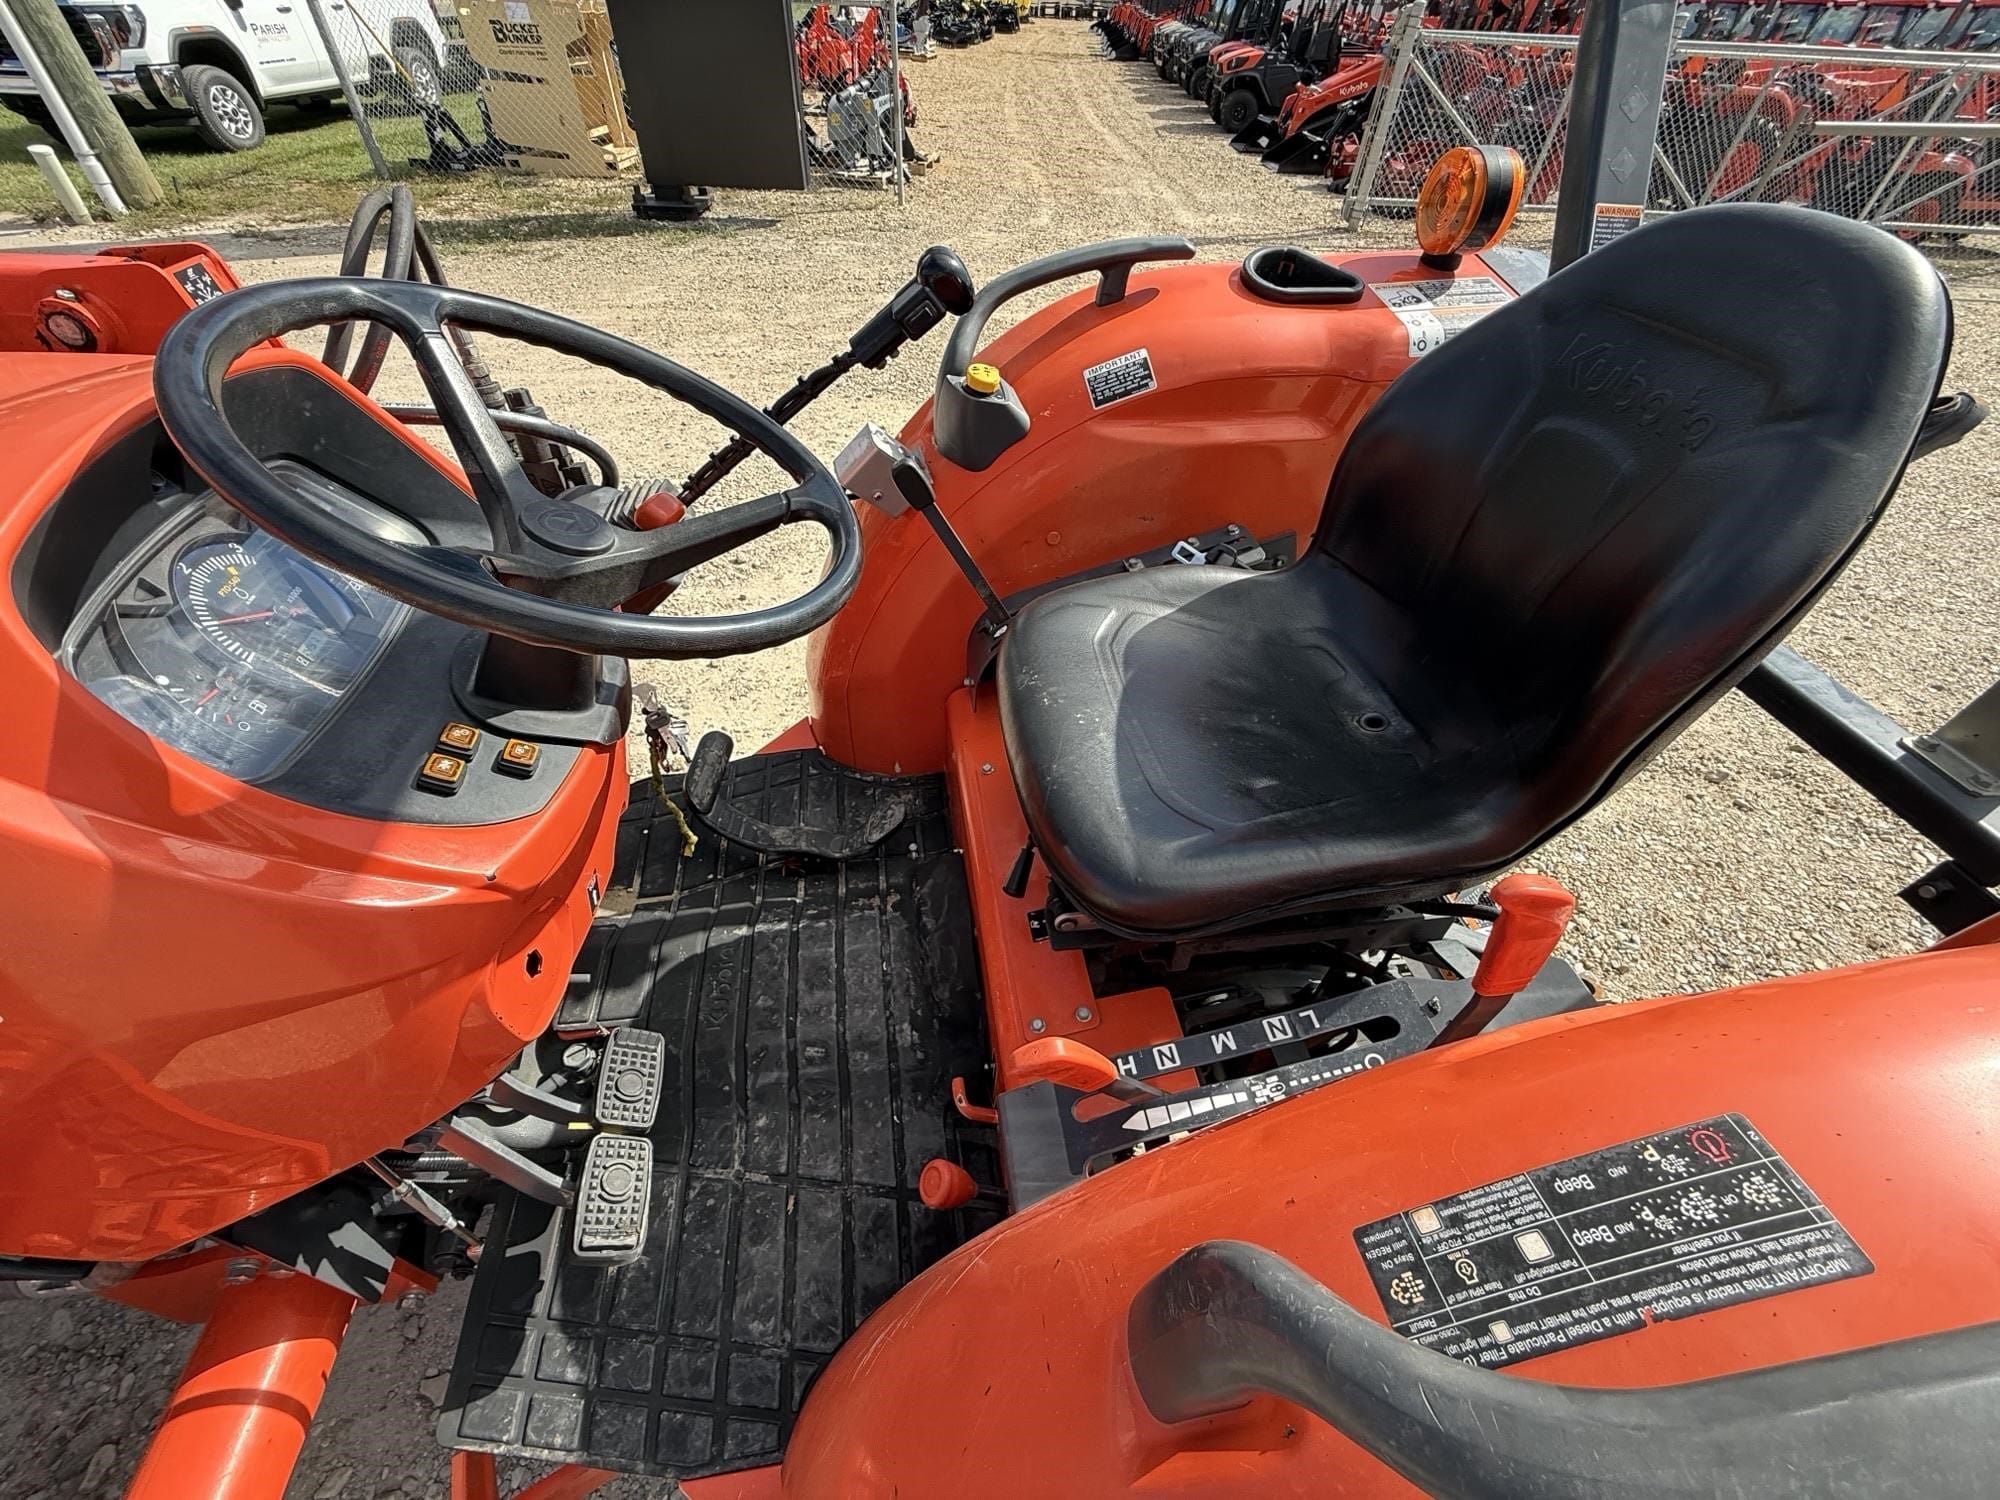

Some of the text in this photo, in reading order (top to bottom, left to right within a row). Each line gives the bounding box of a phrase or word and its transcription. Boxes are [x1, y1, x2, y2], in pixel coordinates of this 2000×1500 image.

[250, 23, 288, 36] PARISH
[1340, 81, 1368, 96] Kubota
[1604, 206, 1640, 216] WARNING
[1087, 351, 1141, 375] IMPORTANT
[229, 543, 243, 553] 3
[177, 563, 192, 575] 2
[1117, 1010, 1320, 1075] L N M N H
[1745, 1130, 1760, 1141] 2
[1489, 1178, 1513, 1190] REGEN
[1550, 1164, 1629, 1198] AND Beep
[1439, 1183, 1531, 1217] then RPM automatically increases
[1506, 1197, 1521, 1206] OFF
[1519, 1191, 1537, 1202] Inhibit
[1719, 1193, 1739, 1205] OR
[1483, 1203, 1500, 1214] Push
[1503, 1206, 1525, 1218] Control
[1523, 1199, 1543, 1211] Speed
[1463, 1219, 1484, 1230] neutral
[1488, 1212, 1506, 1223] Pedal
[1360, 1227, 1394, 1244] complete.
[1435, 1209, 1549, 1251] Park outside Parking brake ON PTO OFF
[1438, 1226, 1461, 1239] Throttle
[1568, 1220, 1635, 1250] AND Beep
[1421, 1236, 1433, 1245] idle
[1669, 1230, 1742, 1256] If you see/hear
[1752, 1238, 1781, 1254] flash,
[1778, 1229, 1824, 1249] indicators
[1831, 1242, 1843, 1251] If
[1365, 1238, 1408, 1259] until REGEN
[1727, 1245, 1757, 1260] follow
[1794, 1251, 1807, 1260] is
[1803, 1243, 1835, 1258] tractor
[1380, 1251, 1414, 1269] Stays ON
[1558, 1258, 1578, 1270] Push
[1675, 1258, 1707, 1273] below.
[1703, 1252, 1731, 1266] chart
[1745, 1258, 1771, 1272] used
[1766, 1250, 1797, 1266] being
[1698, 1273, 1712, 1283] or
[1709, 1263, 1748, 1281] indoors,
[1483, 1280, 1502, 1291] Raise
[1689, 1276, 1701, 1286] in
[1454, 1290, 1469, 1301] until
[1467, 1285, 1485, 1297] RPM
[1507, 1285, 1541, 1302] Do this
[1630, 1280, 1684, 1302] combustible
[1689, 1292, 1706, 1305] is
[1702, 1281, 1745, 1302] tractor
[1584, 1299, 1609, 1314] push
[1606, 1294, 1632, 1307] area,
[1537, 1311, 1573, 1328] INHIBIT
[1570, 1307, 1587, 1319] the
[1611, 1310, 1639, 1326] with
[1408, 1317, 1436, 1332] Result
[1510, 1321, 1538, 1336] button
[1601, 1317, 1612, 1326] a
[1564, 1320, 1603, 1339] Diesel
[1457, 1337, 1478, 1352] light
[1475, 1331, 1495, 1347] (will
[1505, 1329, 1567, 1355] Particulate
[1442, 1342, 1460, 1357] up).
[1477, 1346, 1507, 1363] Filter
